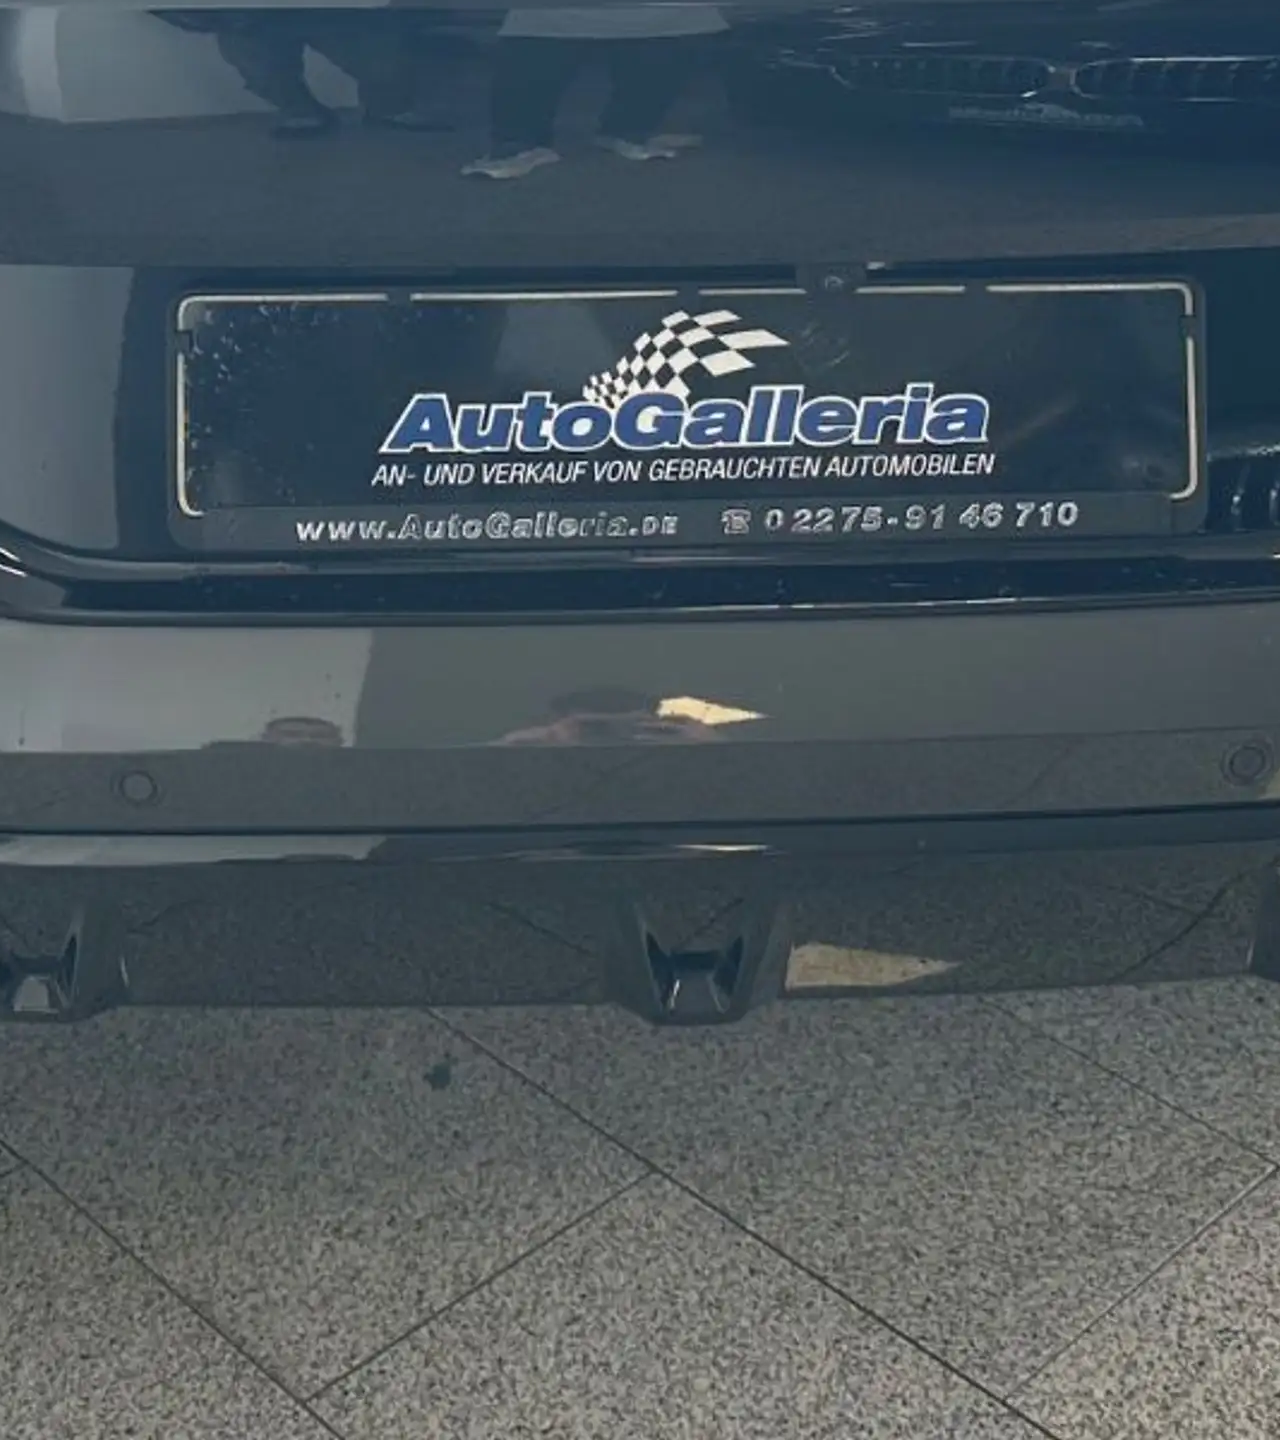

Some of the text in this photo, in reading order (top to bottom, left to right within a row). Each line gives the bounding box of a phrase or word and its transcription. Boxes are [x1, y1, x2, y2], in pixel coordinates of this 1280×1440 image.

[377, 382, 990, 455] AutoGalleria
[371, 453, 996, 487] AN- UND VERKAUF VON GEBRAUCHTEN AUTOMOBILEN
